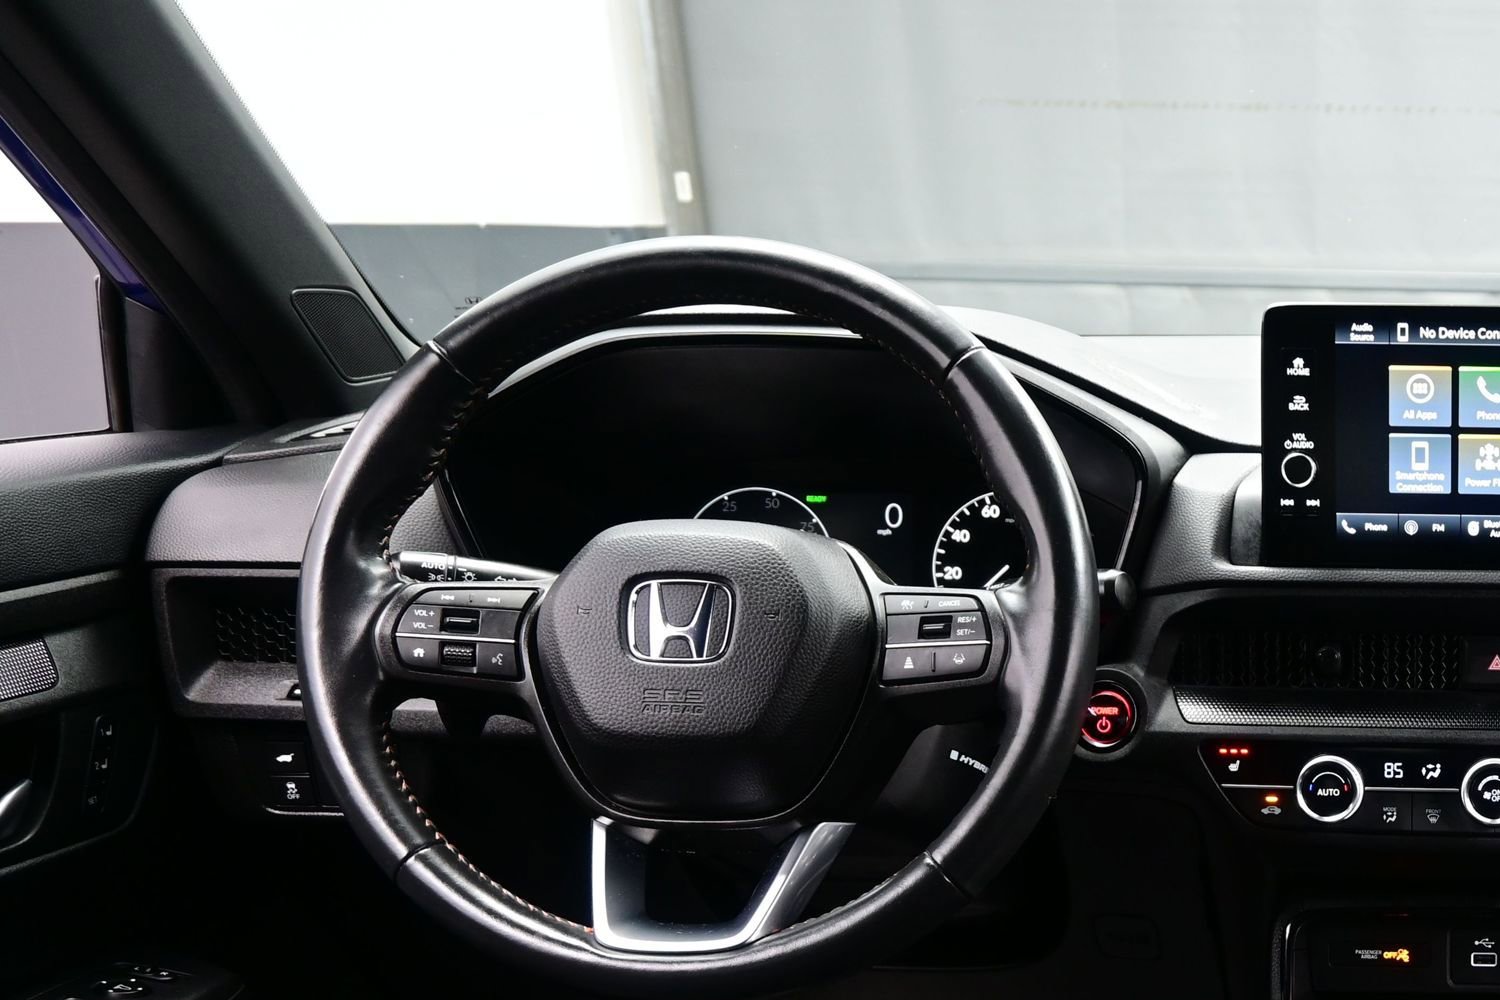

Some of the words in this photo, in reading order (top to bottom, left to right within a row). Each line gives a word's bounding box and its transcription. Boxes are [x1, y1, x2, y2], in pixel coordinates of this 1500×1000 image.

[1351, 323, 1373, 332] Audio
[1350, 333, 1375, 342] Source
[1420, 327, 1436, 339] No
[1438, 327, 1475, 339] Device
[1287, 367, 1310, 376] HOME
[1288, 402, 1309, 411] BACK
[1403, 410, 1415, 419] All
[1416, 410, 1437, 421] Apps
[1292, 433, 1307, 441] VOL
[1292, 441, 1314, 449] AUDIO
[1395, 471, 1445, 482] Smartphone
[1396, 482, 1444, 492] Connection
[1465, 478, 1491, 488] Power
[722, 501, 737, 512] 25
[765, 498, 780, 509] 50
[885, 503, 903, 528] 0
[981, 505, 1001, 518] 60
[800, 522, 815, 532] 75
[1364, 523, 1388, 532] Phone
[1432, 524, 1445, 532] FM
[951, 529, 970, 542] 40
[421, 562, 445, 570] AUTO
[943, 567, 962, 580] 20
[960, 754, 989, 774] HYBRI
[1384, 762, 1404, 778] 85
[1317, 788, 1340, 796] AUTO
